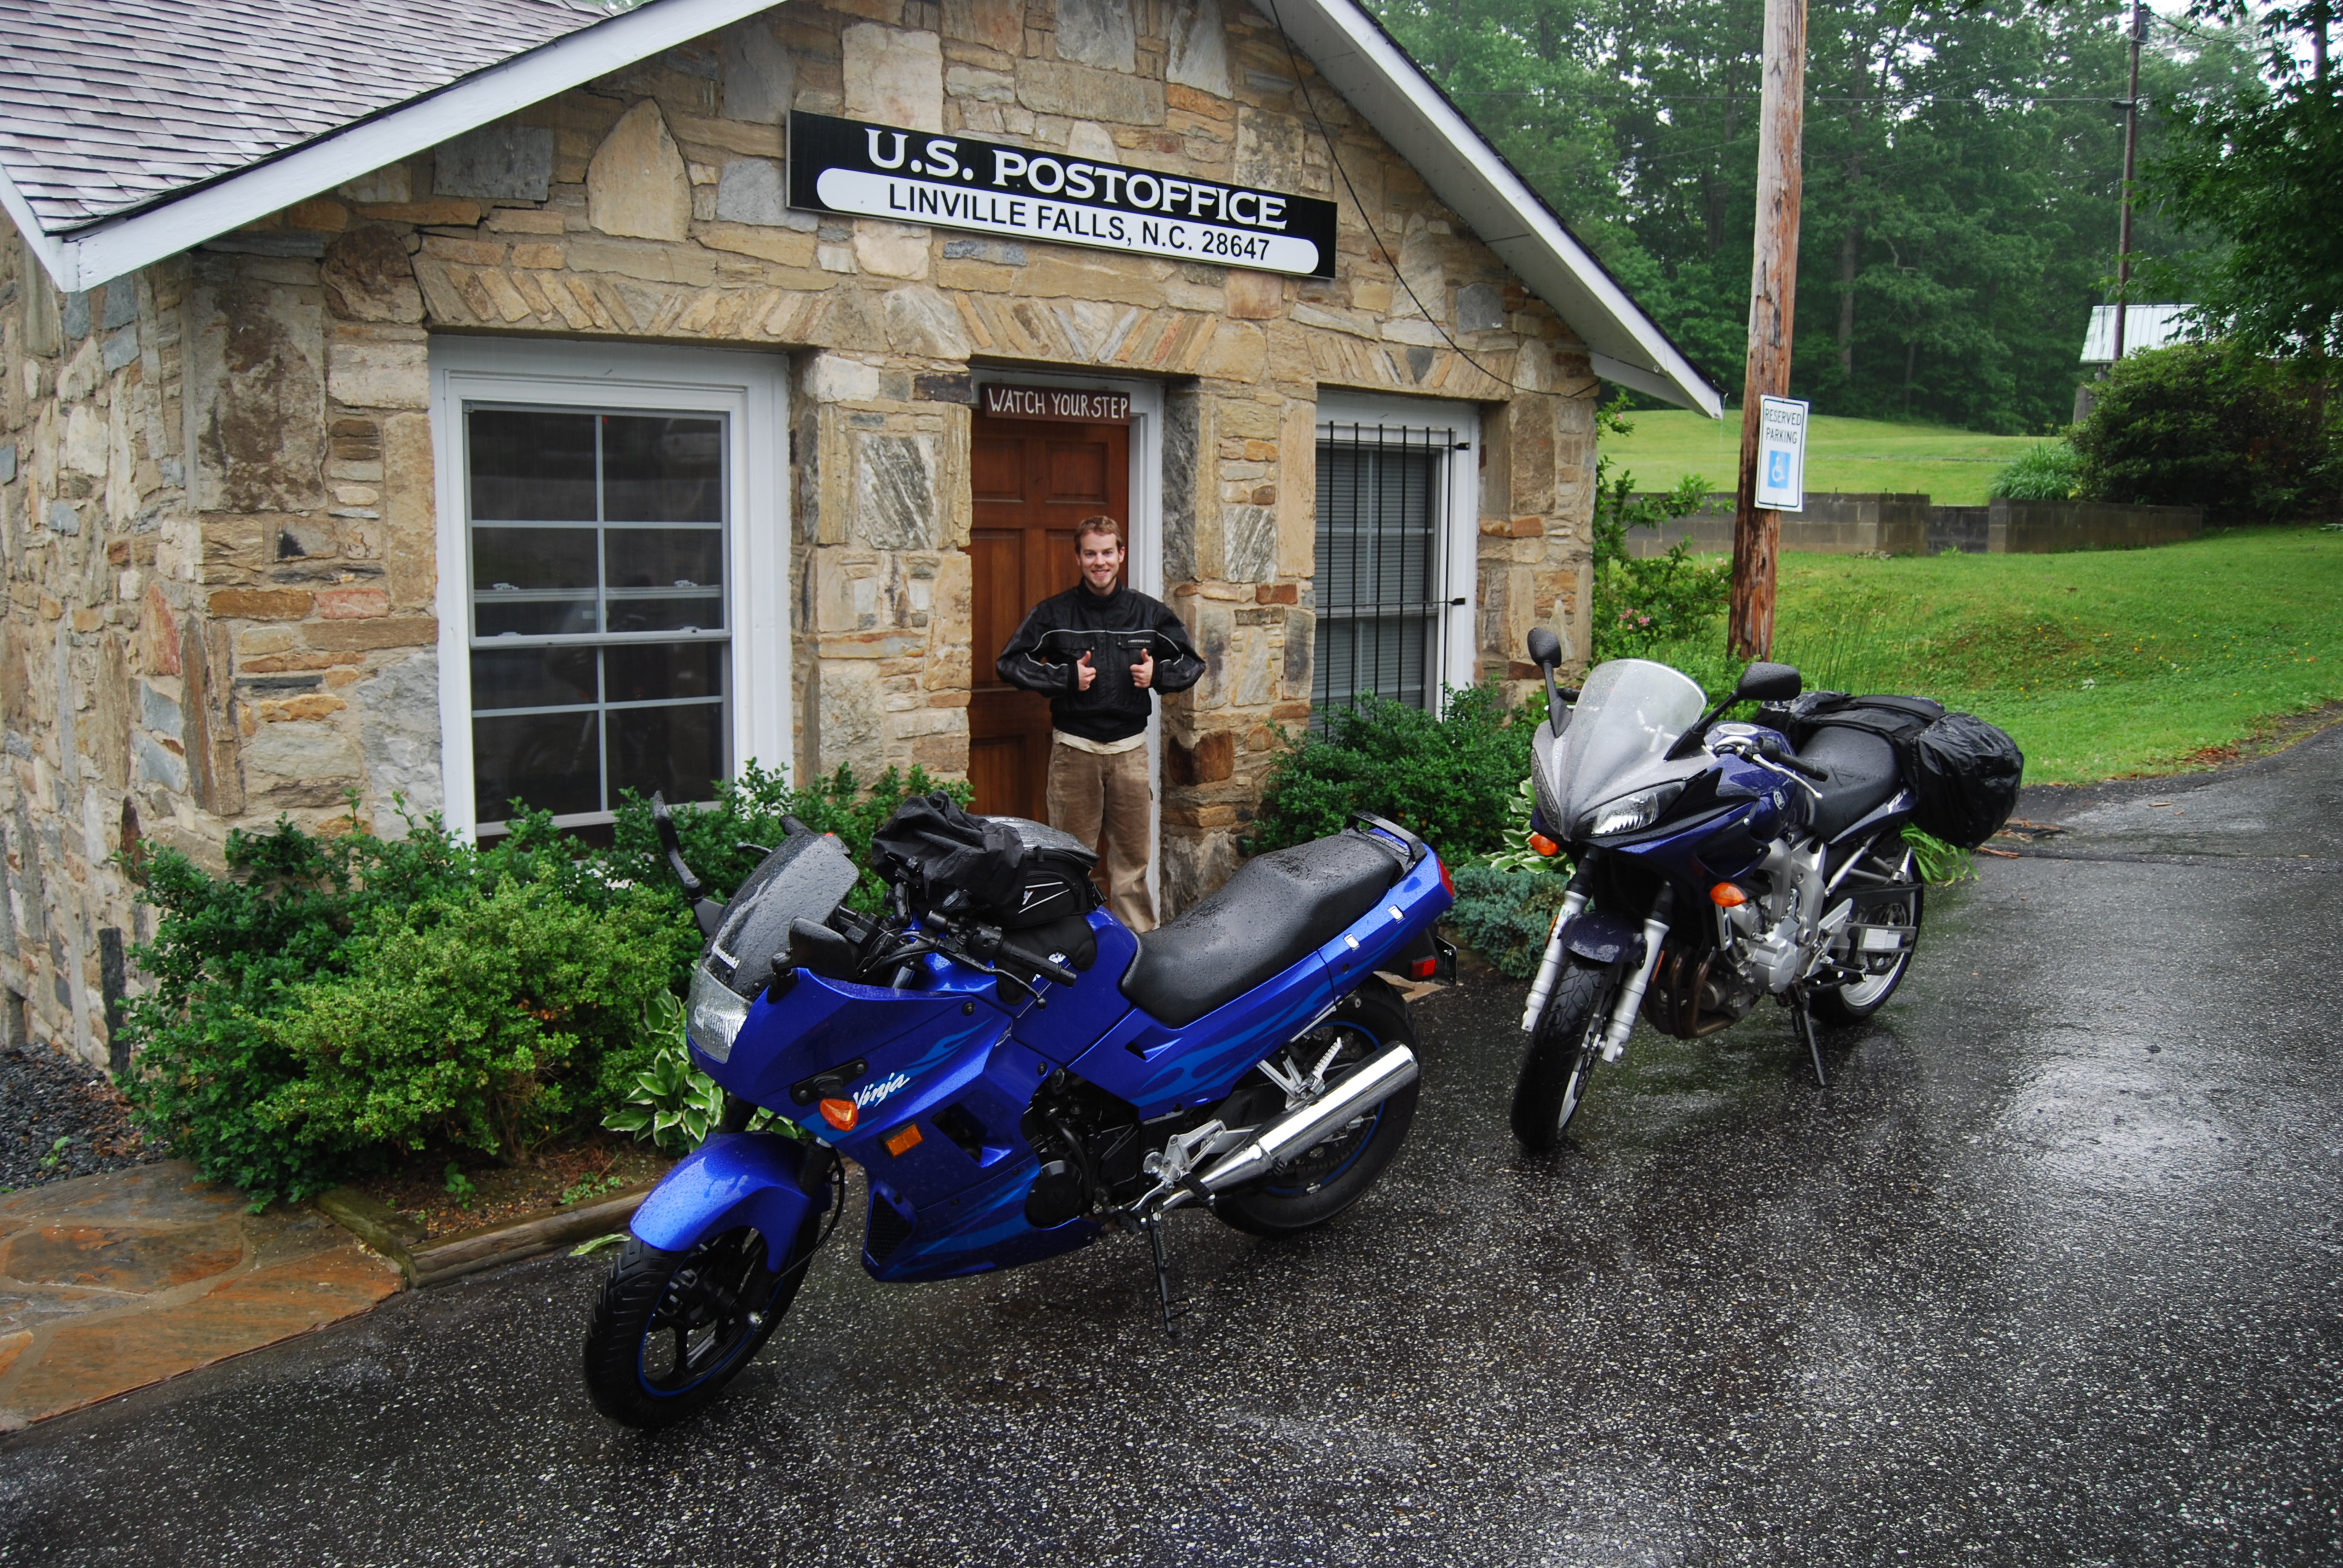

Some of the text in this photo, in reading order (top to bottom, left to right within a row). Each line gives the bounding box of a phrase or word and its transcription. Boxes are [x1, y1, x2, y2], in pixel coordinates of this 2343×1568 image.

[864, 128, 1288, 230] U.S. POSTOFFICE
[890, 183, 1270, 261] LINVILLE FALLS, N.C. 28647
[988, 388, 1128, 419] WATCH YOUR STEP
[1765, 408, 1801, 425] RESERVED
[1766, 428, 1797, 444] PARKING
